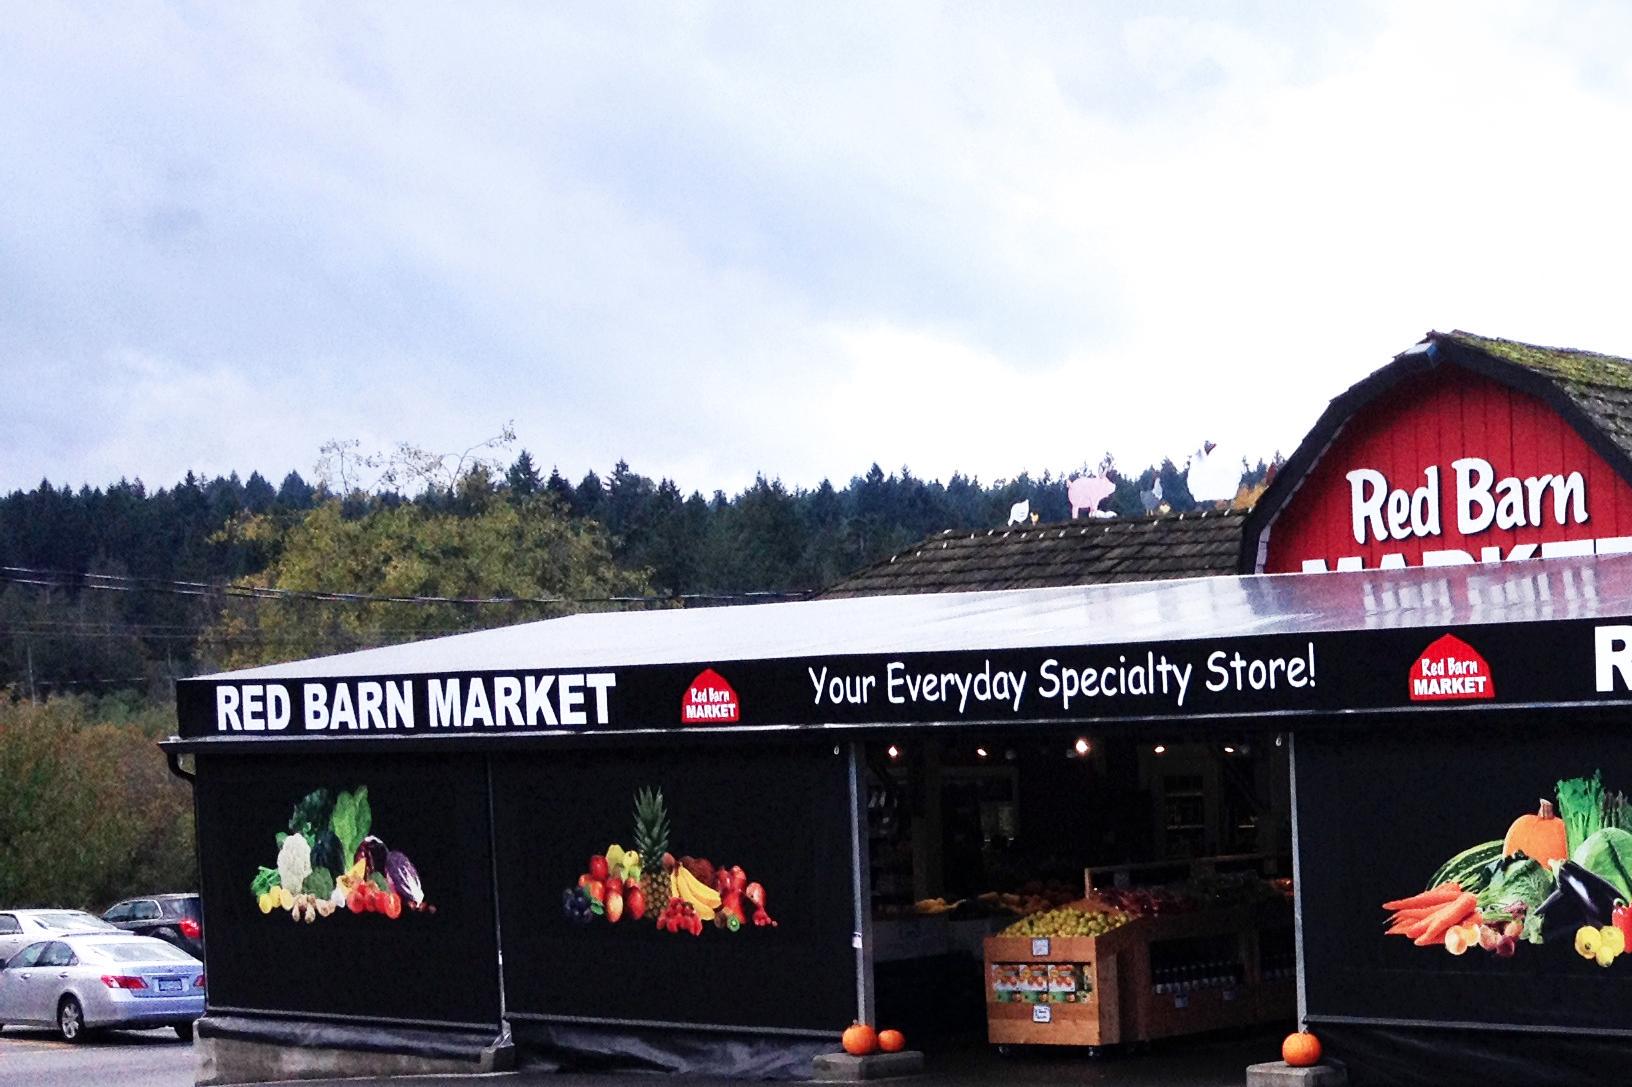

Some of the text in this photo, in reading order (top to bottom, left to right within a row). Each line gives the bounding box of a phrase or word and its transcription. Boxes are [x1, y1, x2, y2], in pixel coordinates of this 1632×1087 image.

[1346, 457, 1589, 545] Red Barn
[1421, 657, 1478, 676] Red Barn
[808, 642, 1316, 713] Your Everyday Specialty Store!
[1413, 676, 1487, 695] MARKET
[216, 672, 617, 731] RED BARN MARKET
[691, 687, 730, 702] Red Barn
[686, 703, 736, 719] MARKET
